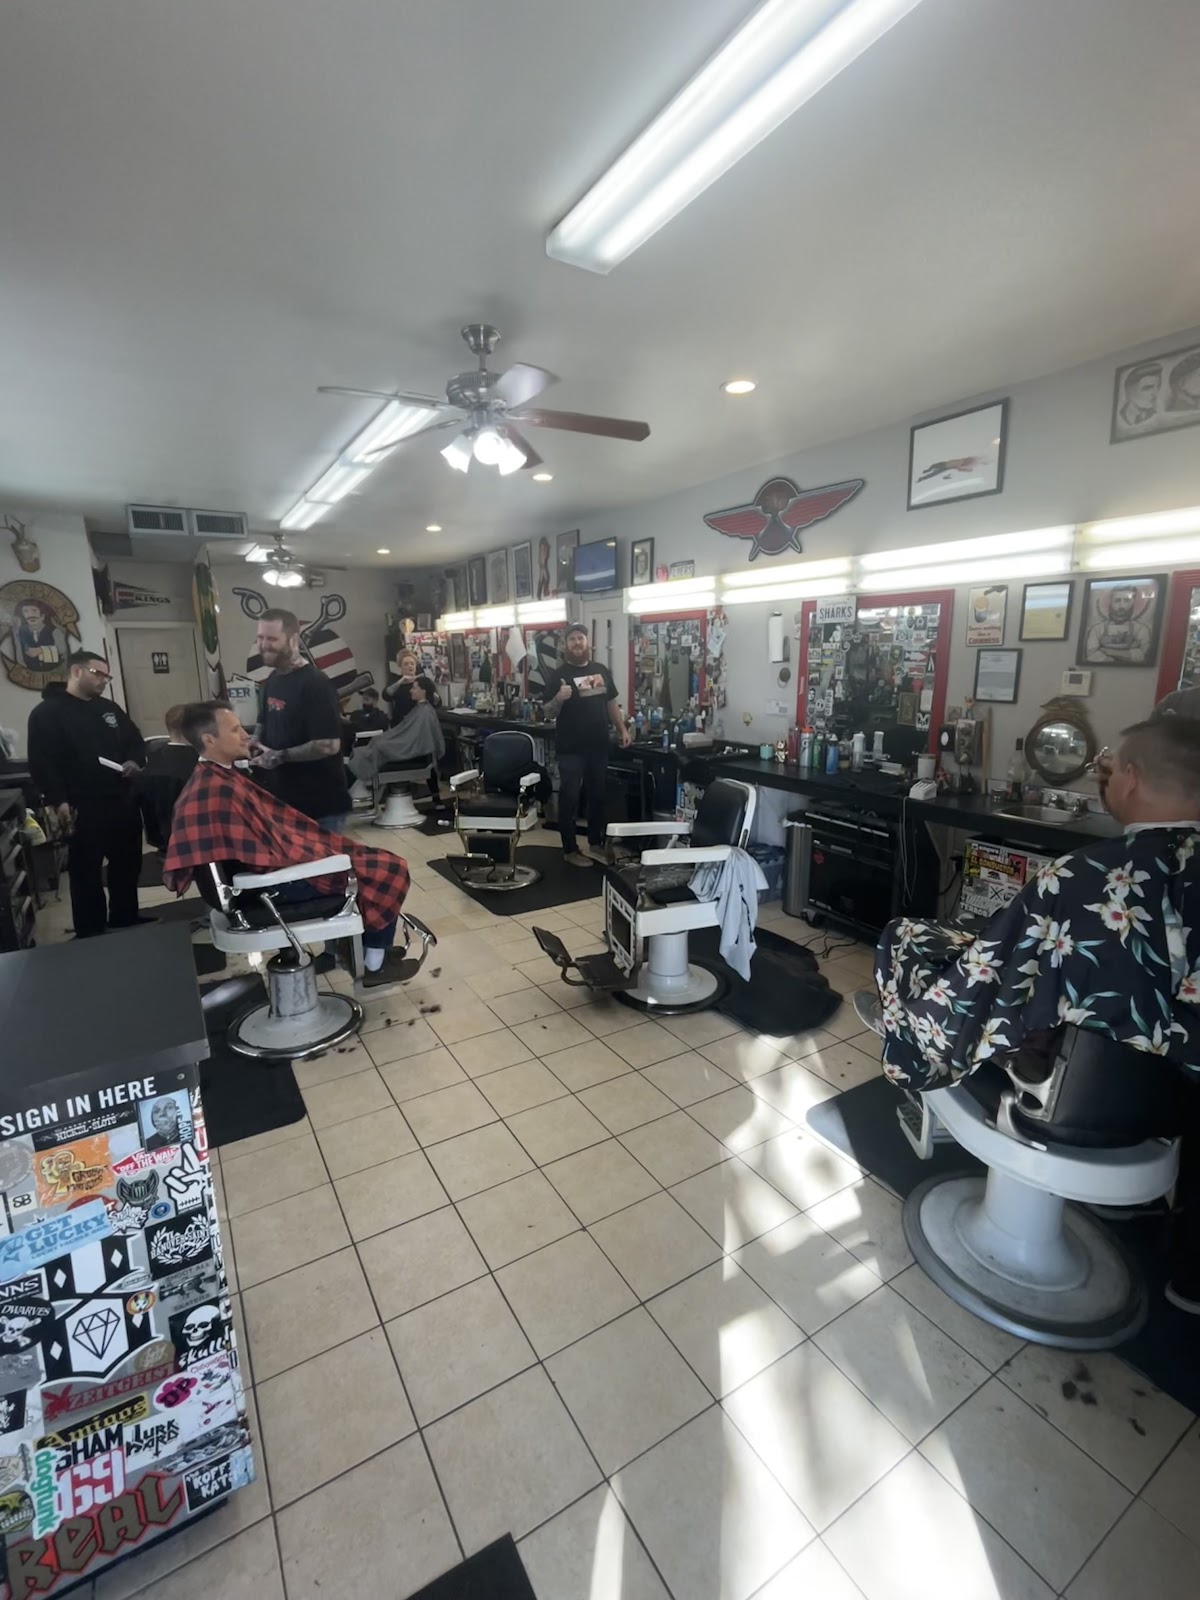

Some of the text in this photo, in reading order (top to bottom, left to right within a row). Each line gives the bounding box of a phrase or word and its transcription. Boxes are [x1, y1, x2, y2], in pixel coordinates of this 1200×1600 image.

[135, 594, 172, 604] KINGS
[819, 605, 853, 620] SHARKS
[227, 687, 251, 698] EER
[0, 1077, 157, 1136] SIGN IN HERE
[136, 1156, 155, 1169] THE
[24, 1214, 73, 1242] GET
[28, 1213, 106, 1255] LUCKY
[55, 1423, 124, 1472] SHAM
[192, 1461, 231, 1489] KOFF
